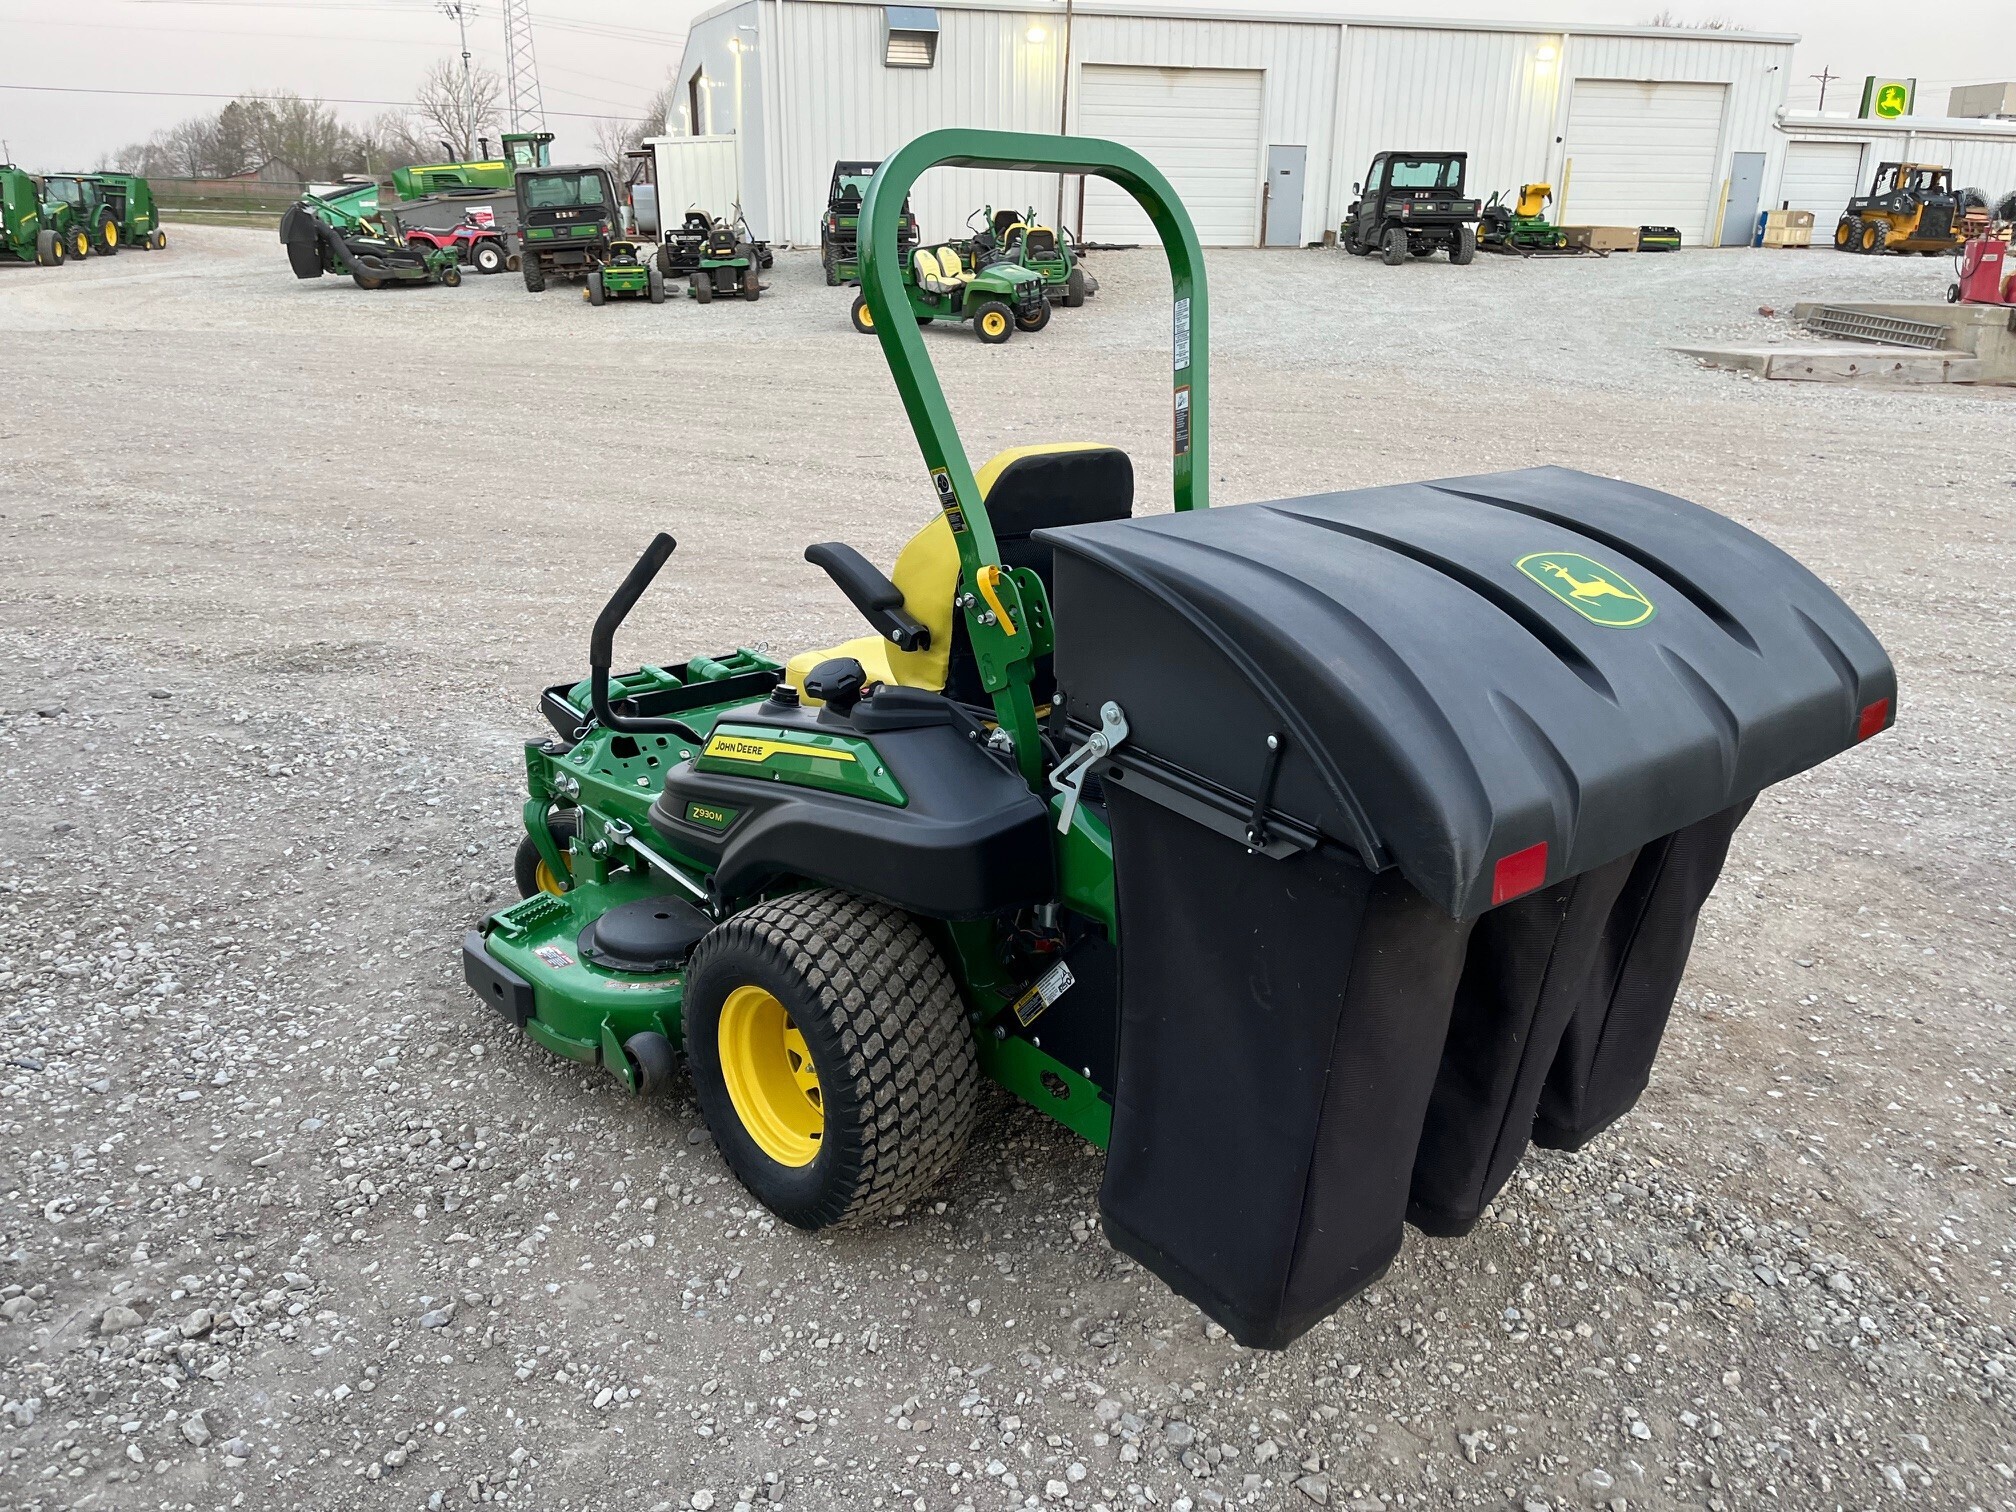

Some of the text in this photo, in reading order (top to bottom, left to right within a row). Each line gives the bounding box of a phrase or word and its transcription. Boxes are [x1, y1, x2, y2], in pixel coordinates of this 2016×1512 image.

[715, 741, 763, 755] JOHN DEERE
[693, 807, 723, 822] Z930M
